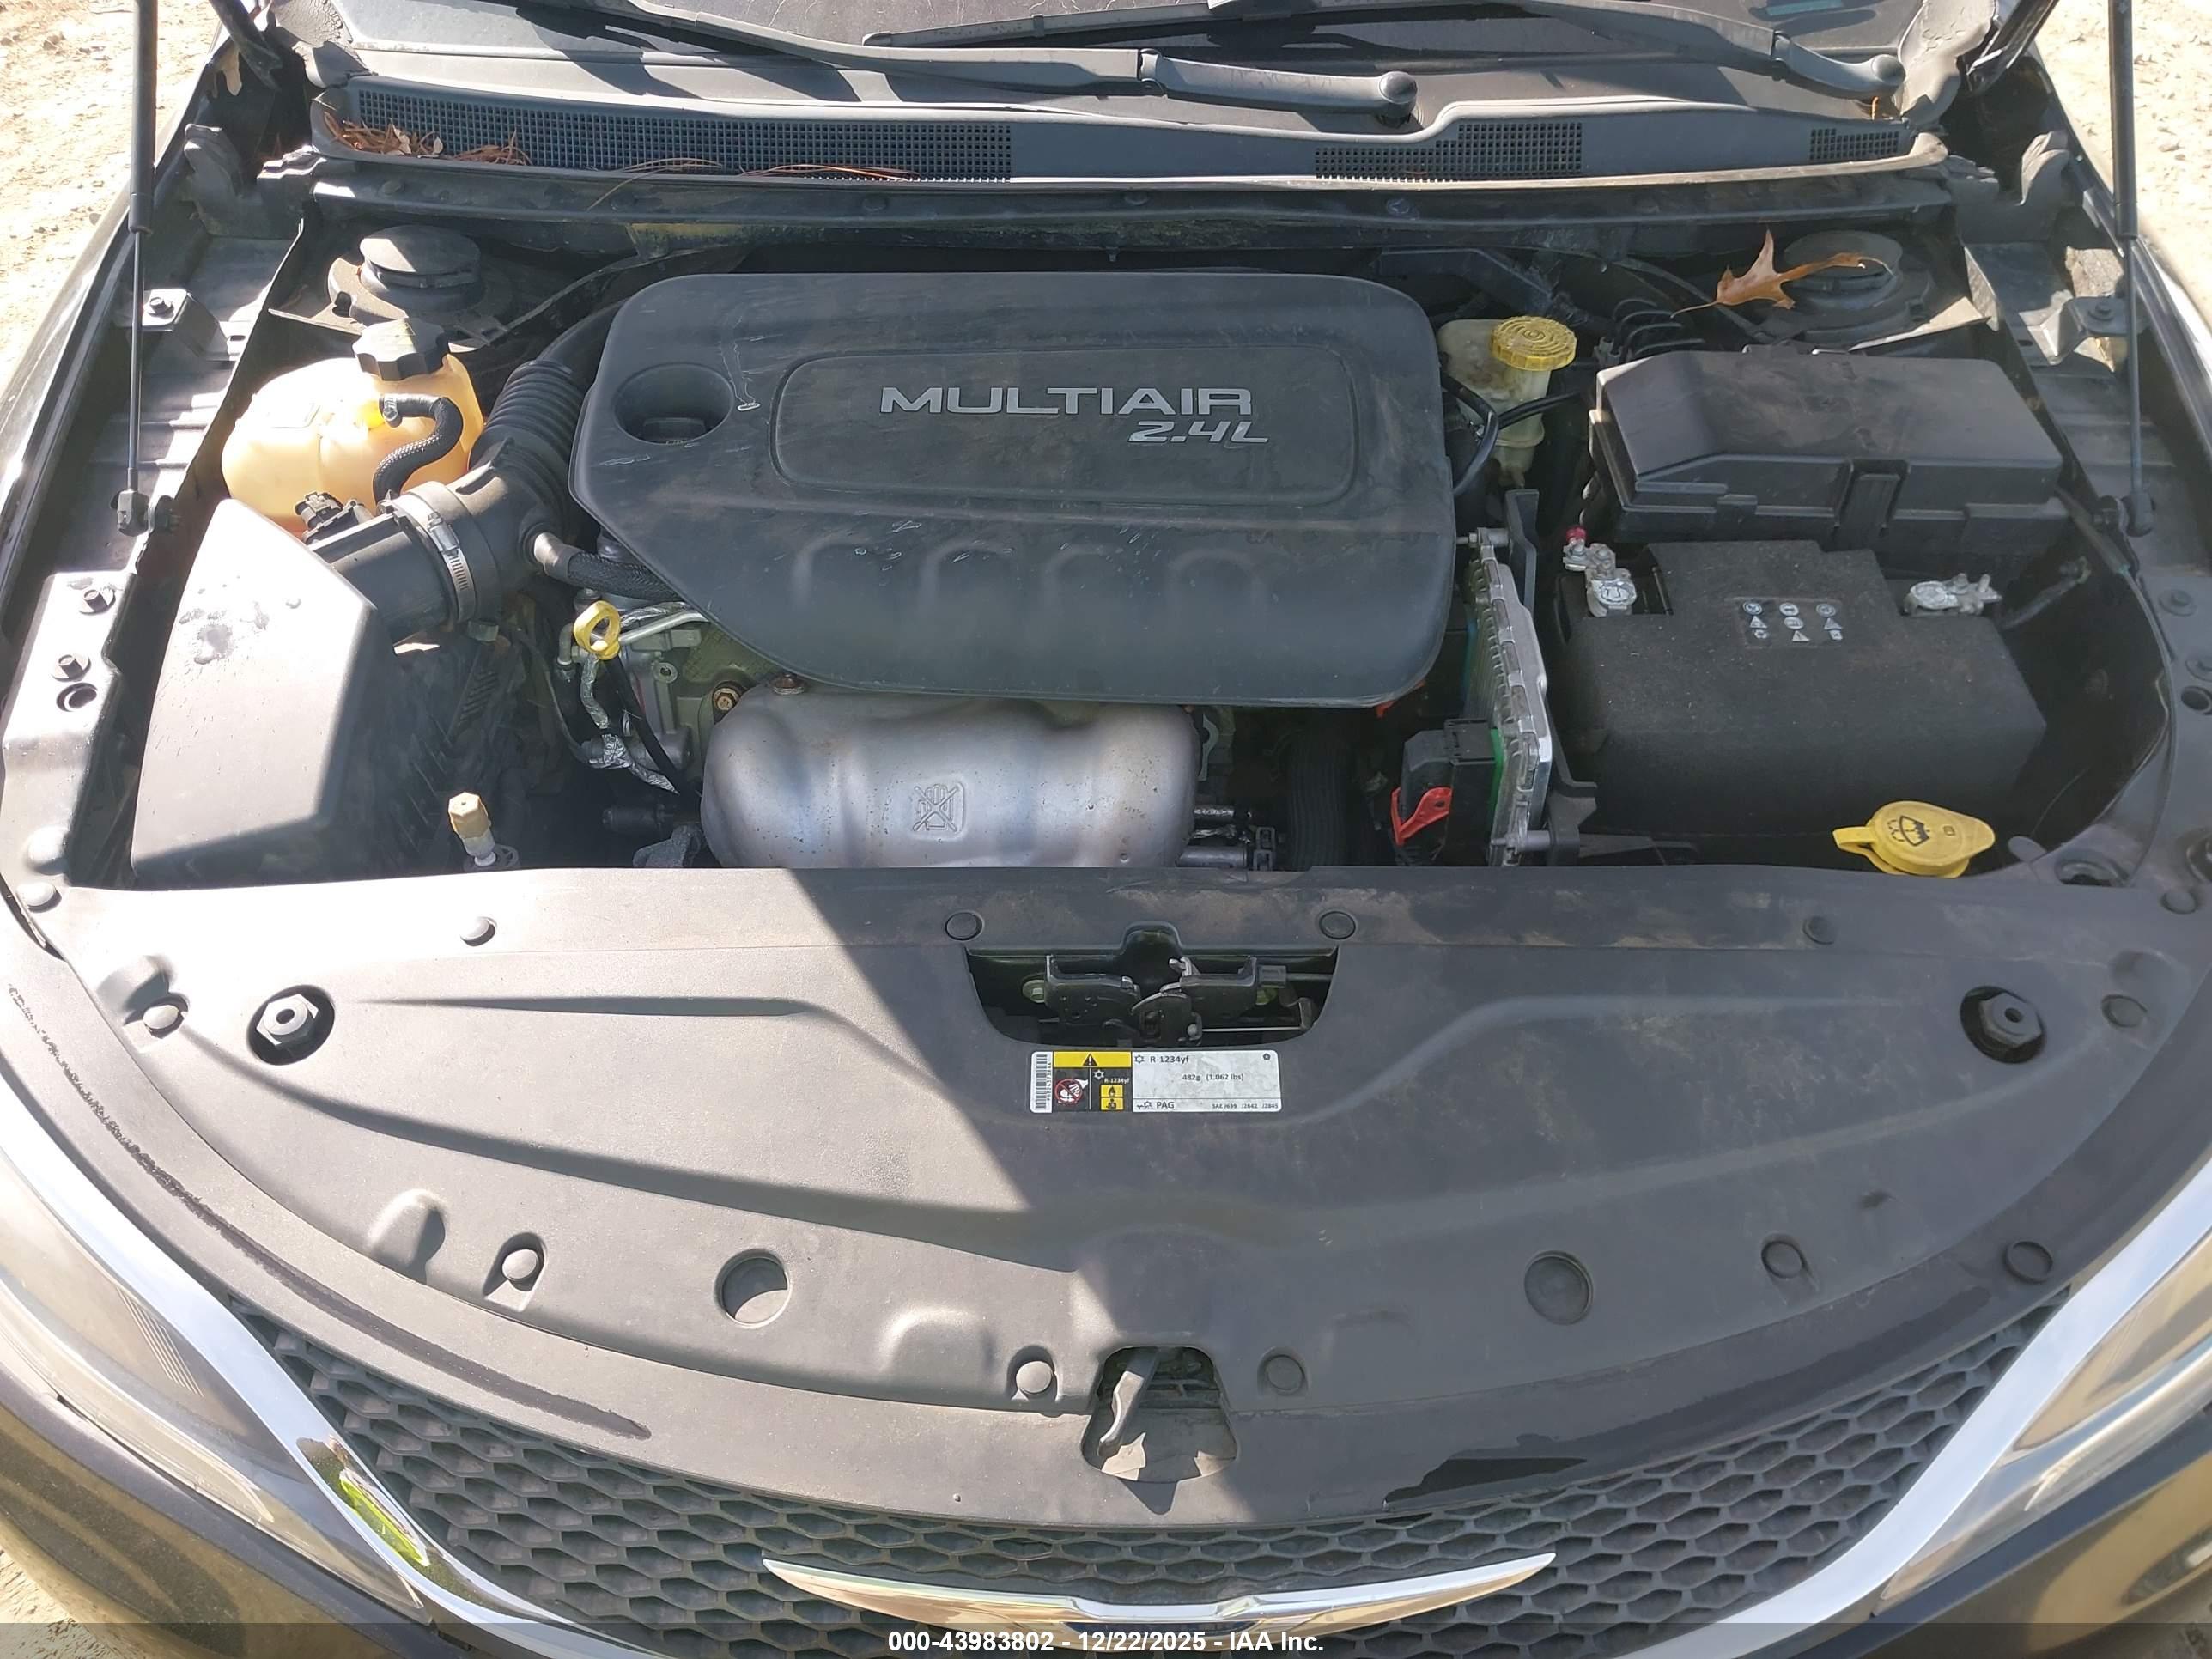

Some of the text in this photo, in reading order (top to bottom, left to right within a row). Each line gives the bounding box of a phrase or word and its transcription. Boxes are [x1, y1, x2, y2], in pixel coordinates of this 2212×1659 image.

[879, 387, 1252, 416] MULTIAIR
[1127, 420, 1269, 443] 2.4L
[1150, 1055, 1189, 1066] R-1234yf
